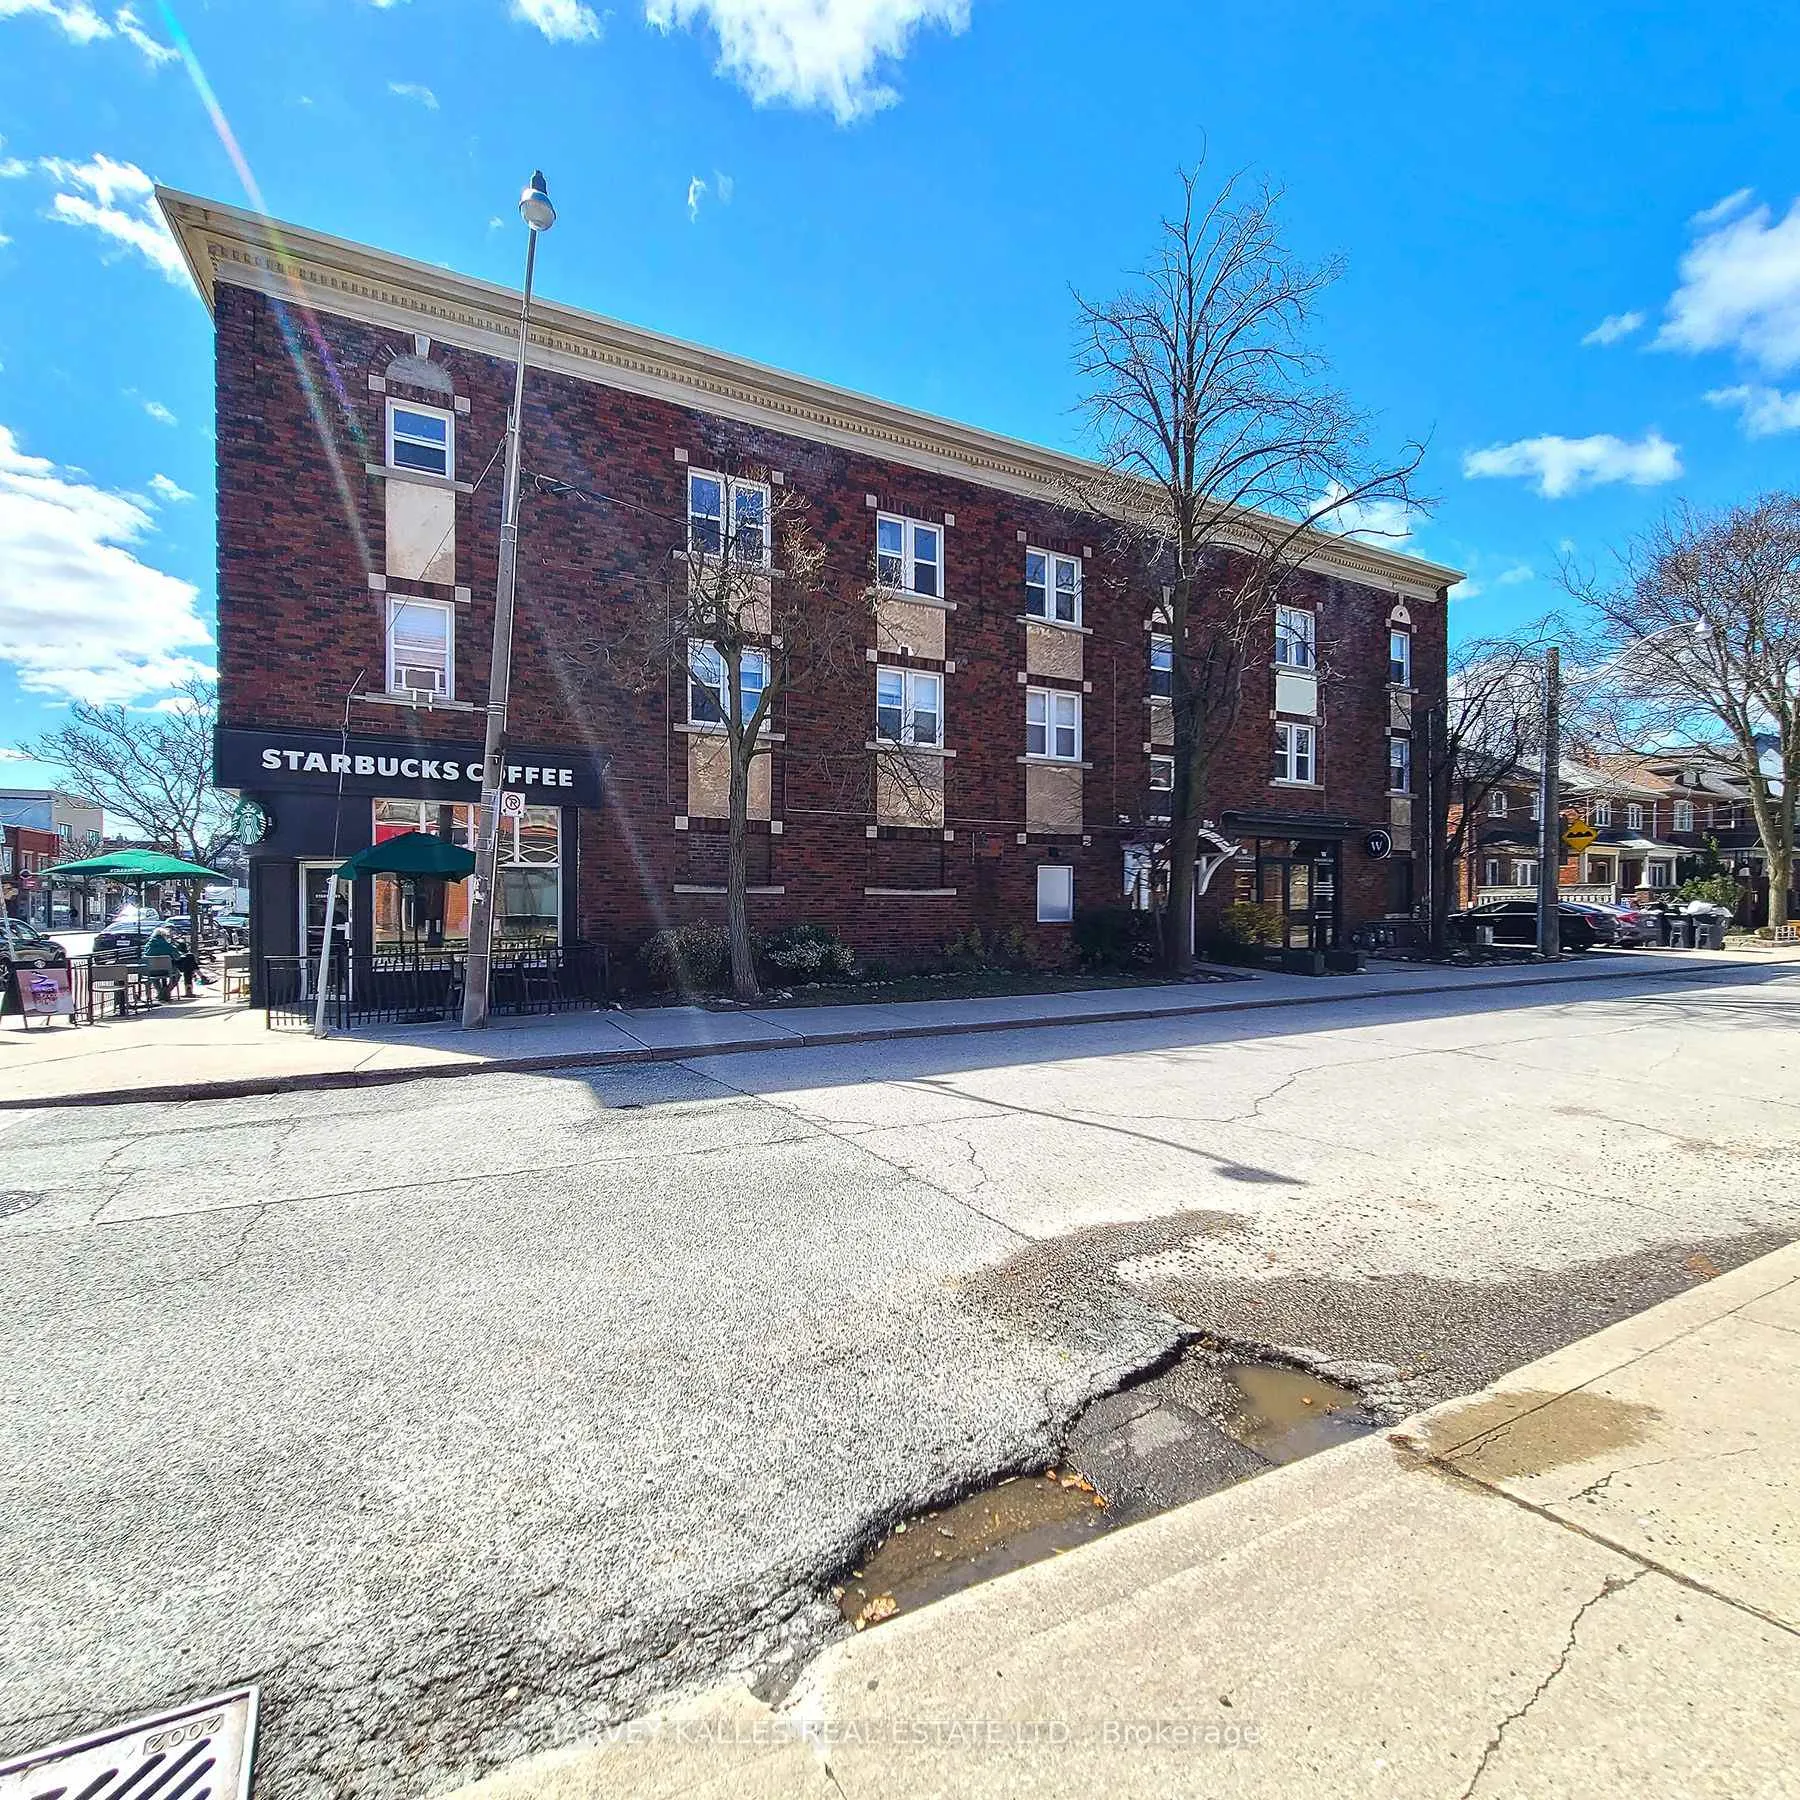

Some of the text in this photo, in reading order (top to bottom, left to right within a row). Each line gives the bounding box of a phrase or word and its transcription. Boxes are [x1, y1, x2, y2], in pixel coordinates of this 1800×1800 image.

[261, 748, 574, 788] STARBUCKS CFFEE
[1370, 840, 1383, 851] W
